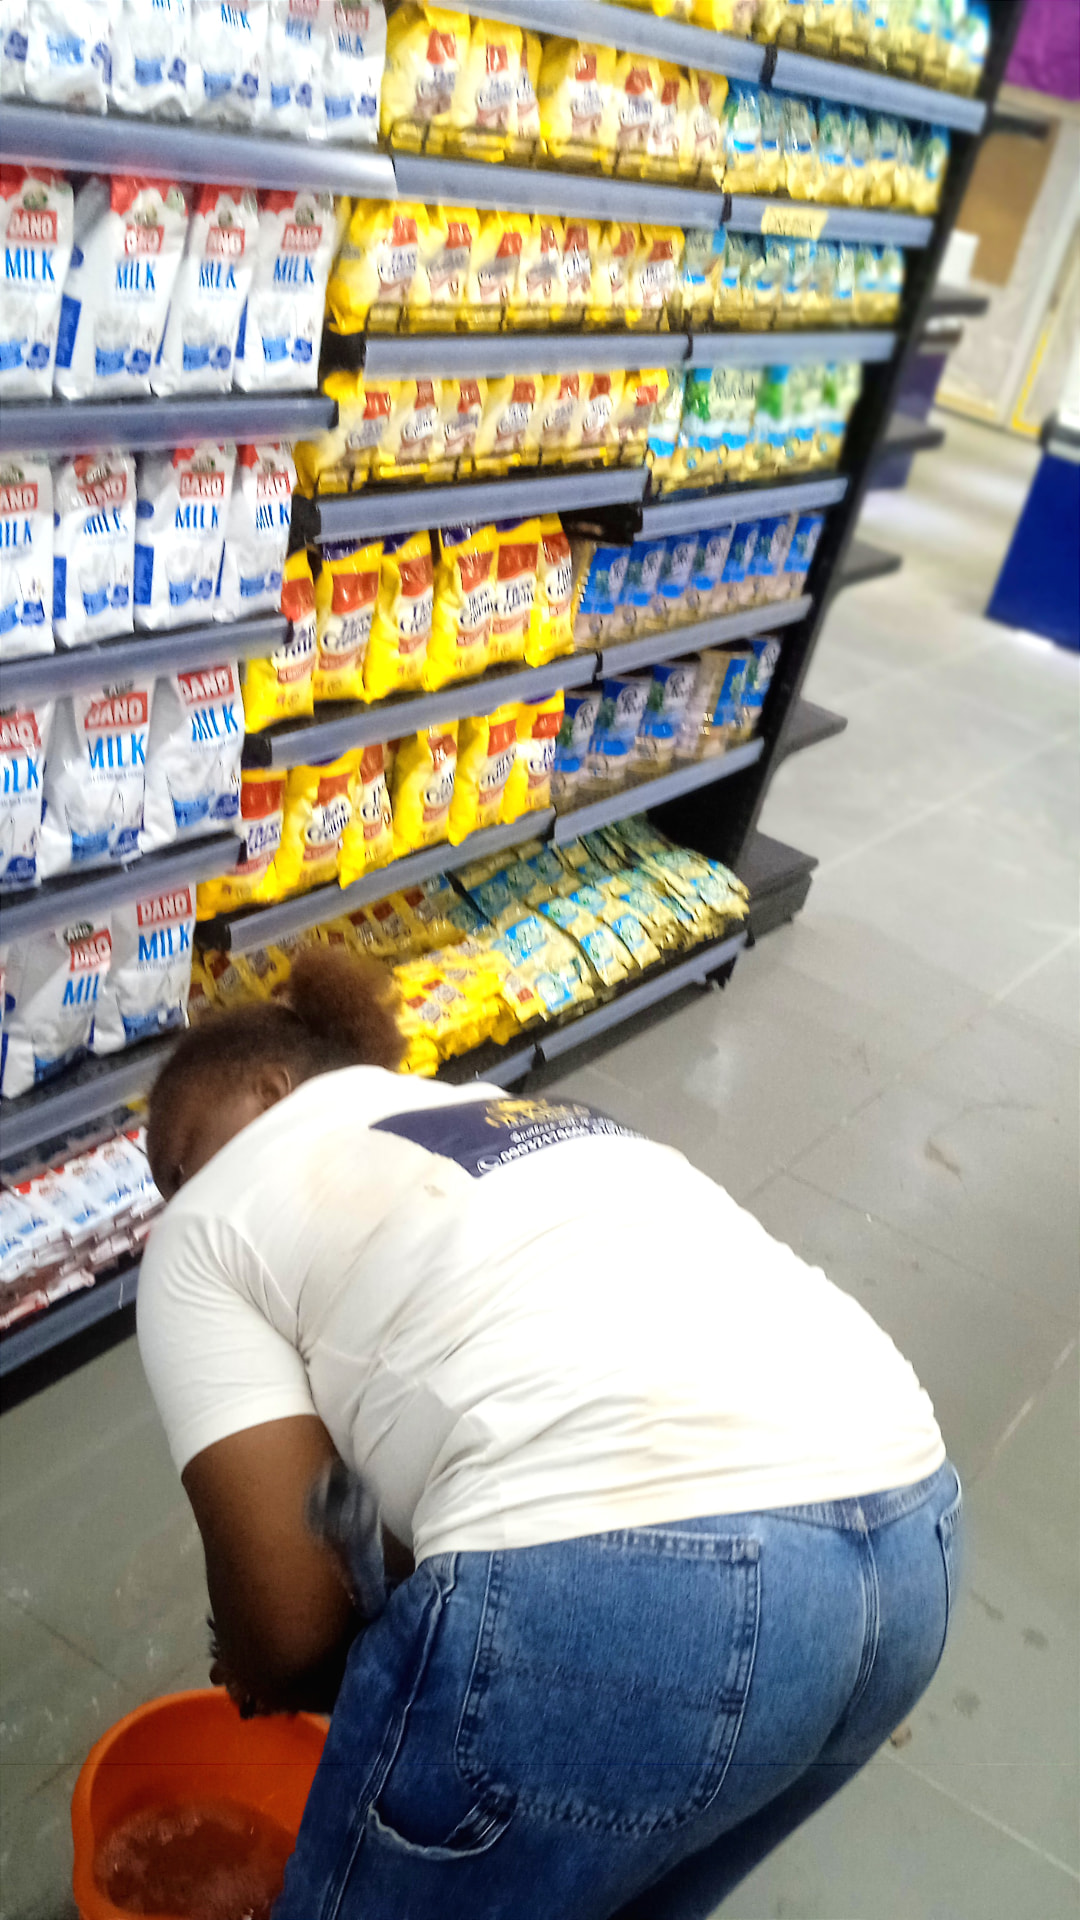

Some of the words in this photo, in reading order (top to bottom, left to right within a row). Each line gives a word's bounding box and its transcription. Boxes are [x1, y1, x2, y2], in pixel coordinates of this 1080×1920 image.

[9, 213, 52, 238] DANO
[5, 247, 55, 281] MILK
[116, 261, 156, 291] MILK
[199, 260, 237, 290] MILK
[273, 256, 315, 284] MILK
[181, 475, 223, 496] DANO
[175, 503, 219, 530] MILK
[256, 502, 290, 530] MILK
[180, 668, 230, 698] DANO
[88, 697, 143, 727] DANO
[191, 703, 239, 742] MILK
[87, 733, 146, 769] MILK
[141, 890, 188, 921] DANO
[138, 922, 191, 961] MILK
